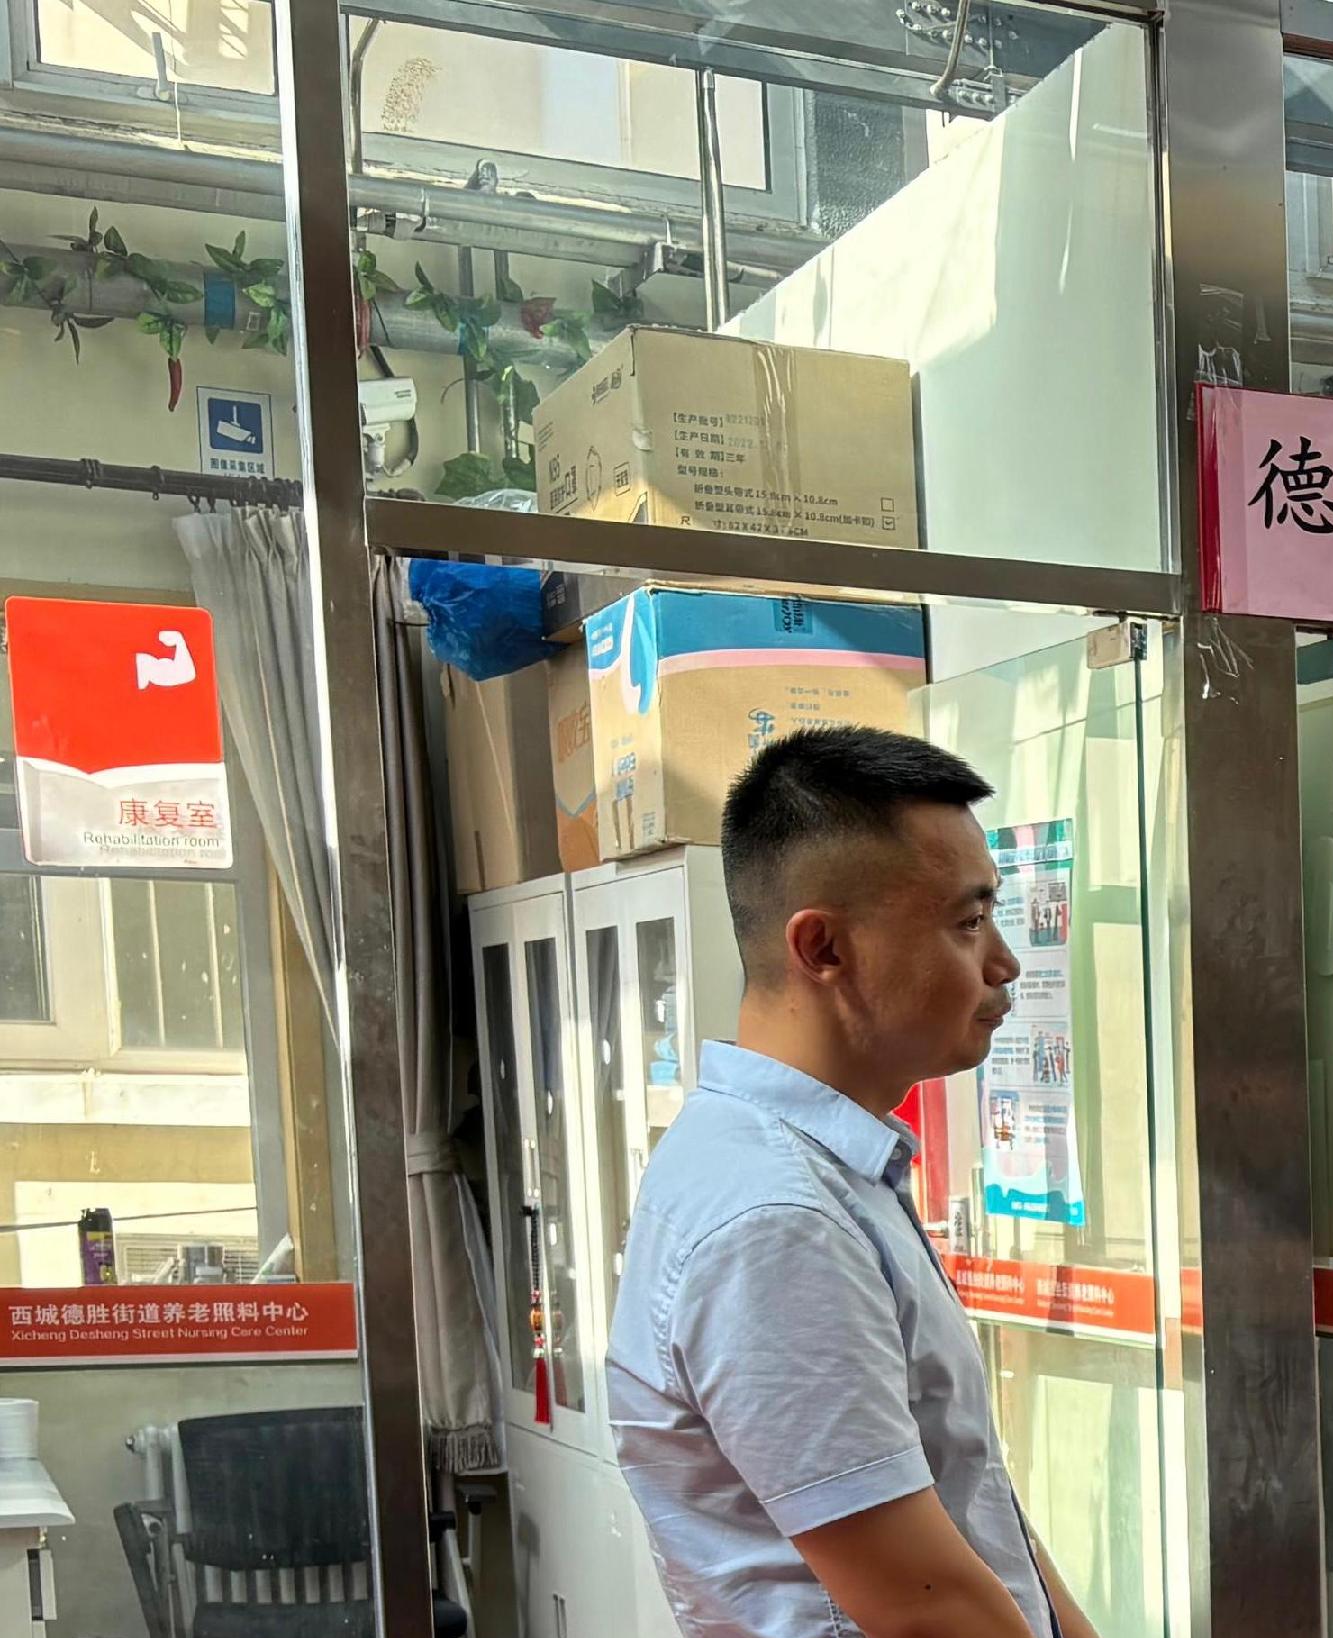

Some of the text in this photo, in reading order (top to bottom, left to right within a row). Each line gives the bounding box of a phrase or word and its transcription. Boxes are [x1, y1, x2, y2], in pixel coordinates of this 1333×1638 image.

[119, 797, 218, 830] 康复室
[83, 831, 220, 848] Rehabilitation room
[8, 1301, 310, 1326] 西城德胜街道养老照料中心
[11, 1327, 67, 1342] Xicheng
[69, 1326, 129, 1341] Desheng
[132, 1327, 175, 1340] Street
[178, 1326, 229, 1341] Nursing
[265, 1326, 310, 1338] Center
